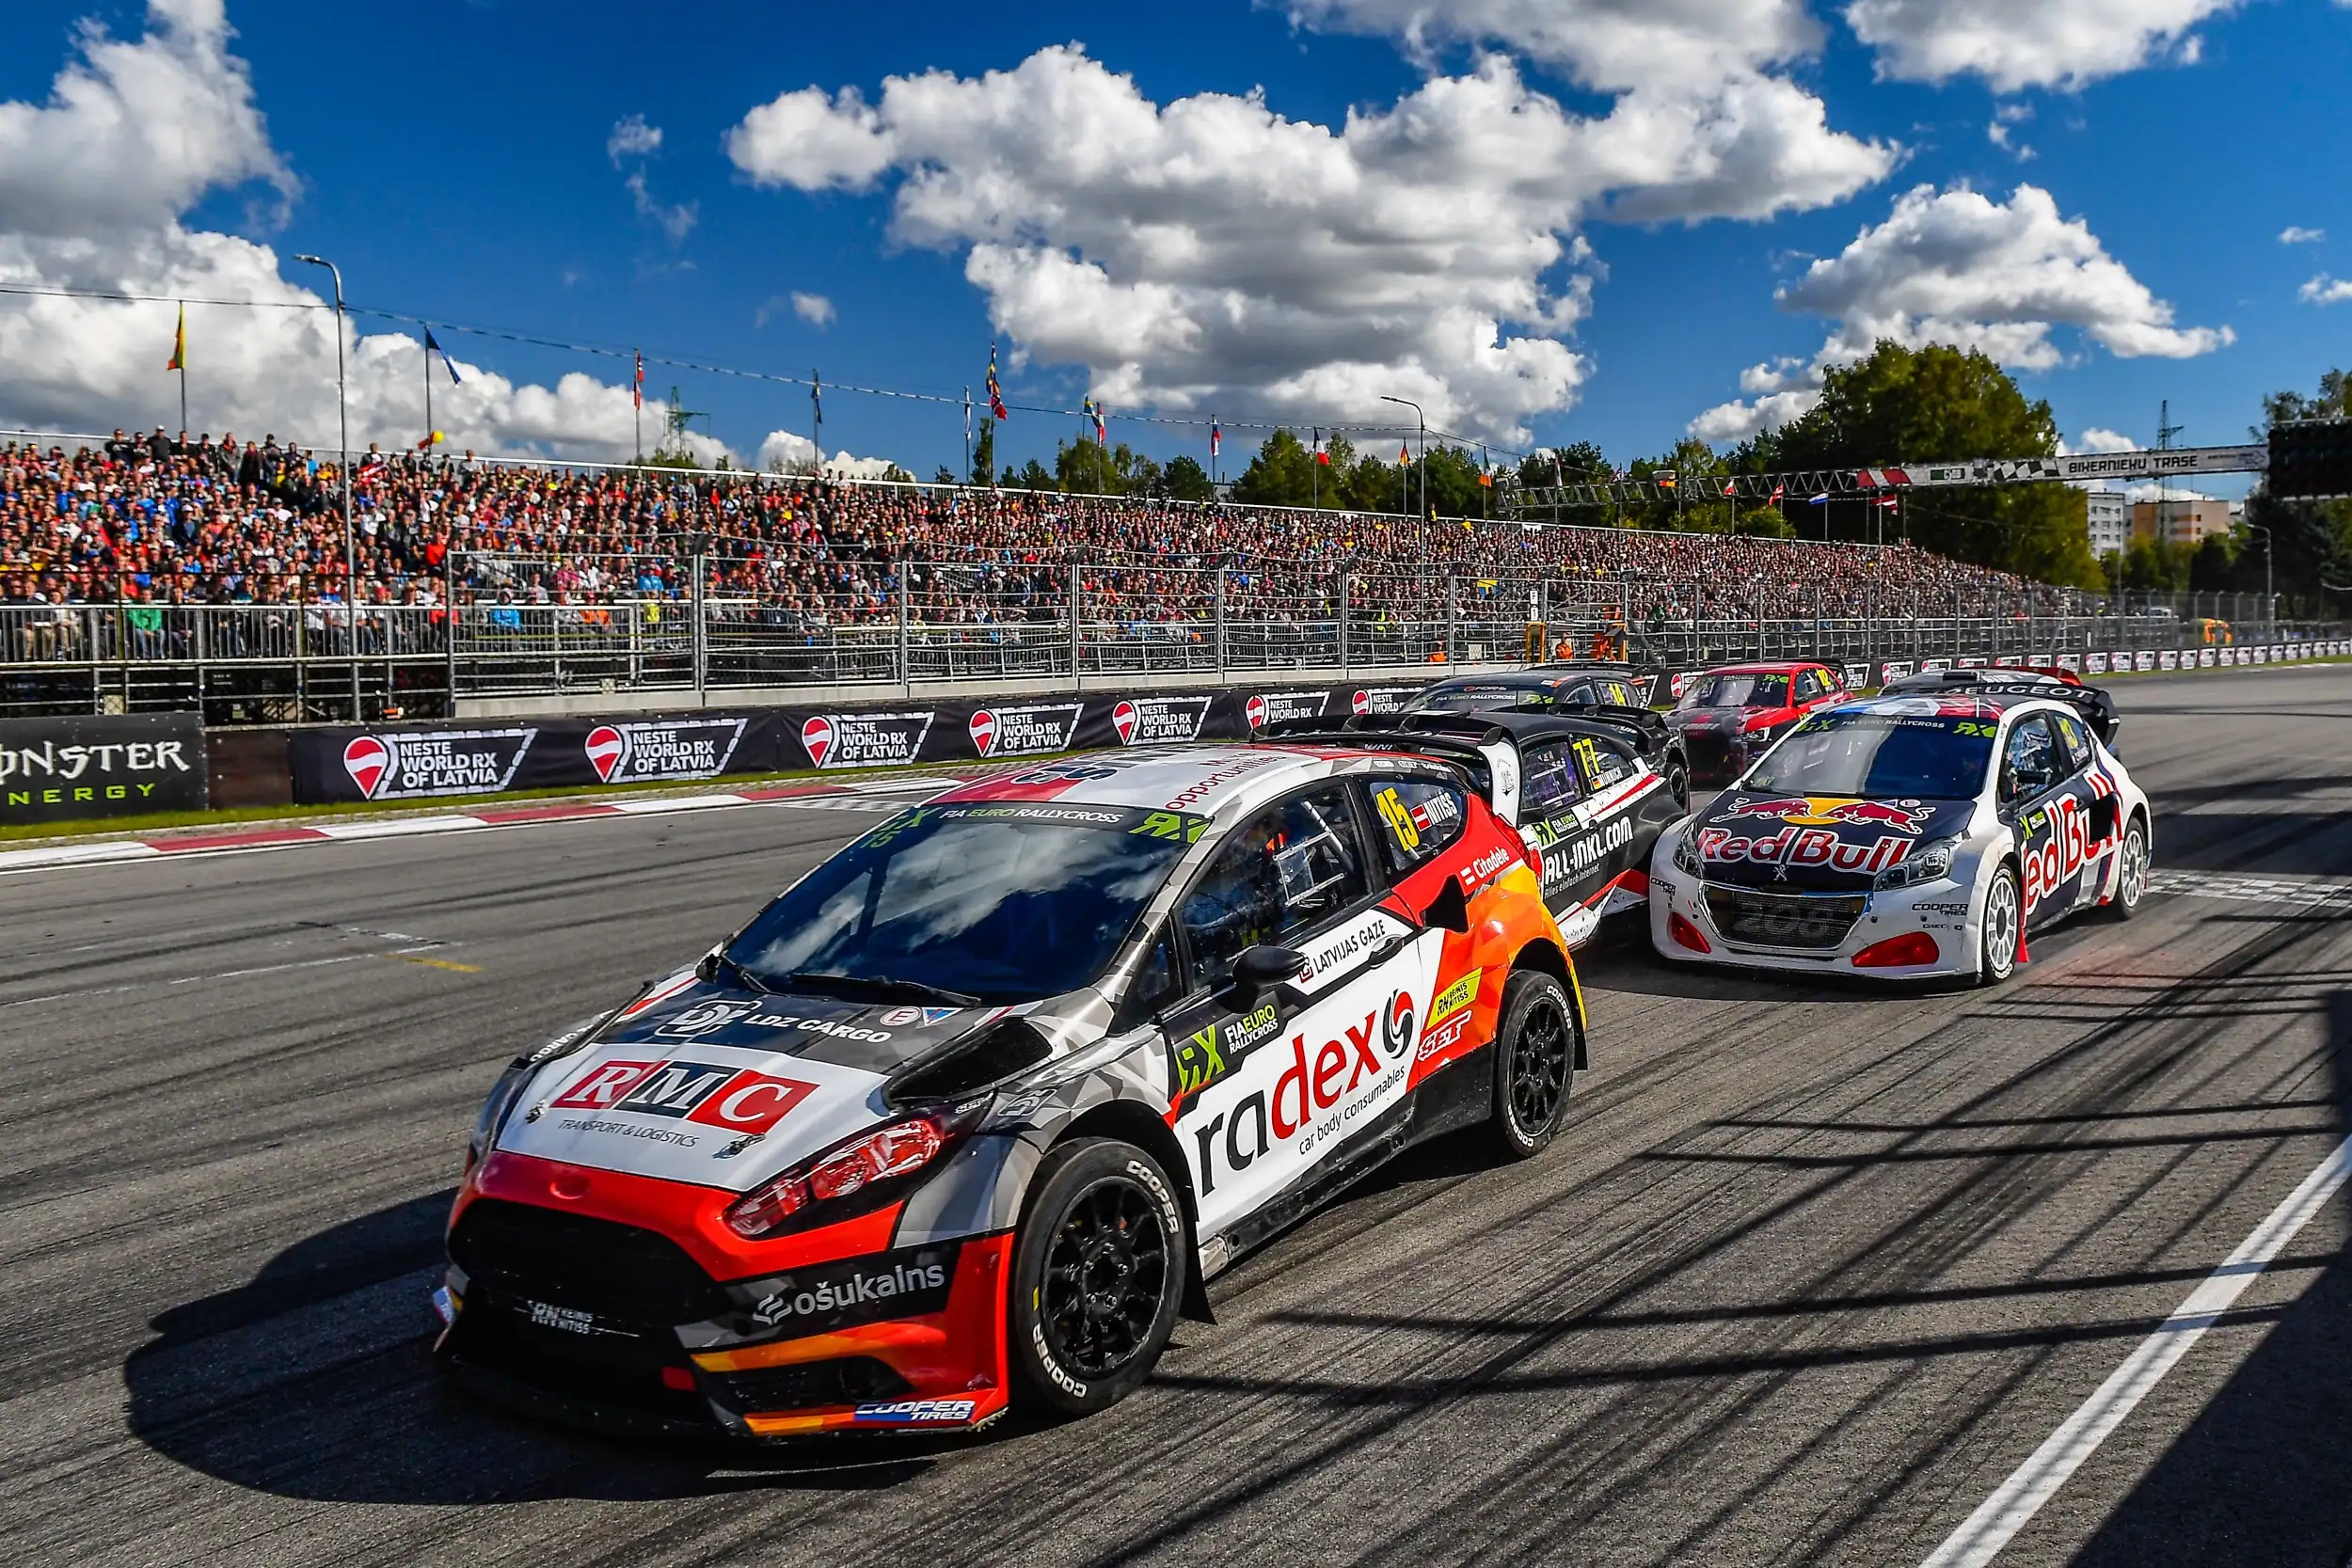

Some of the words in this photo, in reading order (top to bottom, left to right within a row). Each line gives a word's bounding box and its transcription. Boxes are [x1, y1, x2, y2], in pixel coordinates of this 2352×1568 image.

[2153, 455, 2198, 468] TRASE
[1141, 705, 1168, 715] NESTE
[1270, 699, 1293, 709] NESTE
[1270, 708, 1300, 720] WORLD
[1300, 707, 1312, 719] RX
[840, 722, 877, 734] NESTE
[1002, 714, 1034, 725] NESTE
[1003, 723, 1045, 737] WORLD
[1045, 721, 1062, 735] RX
[1141, 714, 1178, 726] WORLD
[1178, 713, 1192, 724] RX
[1884, 719, 1945, 729] RALLYCROSS
[633, 731, 677, 745] NESTE
[841, 732, 890, 747] WORLD
[890, 731, 908, 745] RX
[1143, 726, 1158, 737] OF
[1158, 724, 1193, 736] LATVIA
[400, 741, 452, 757] NESTE
[634, 742, 692, 759] WORLD
[693, 739, 716, 755] RX
[842, 747, 863, 759] OF
[863, 744, 908, 759] LATVIA
[1004, 737, 1022, 750] OF
[1022, 734, 1062, 748] LATVIA
[401, 754, 470, 773] WORLD
[471, 752, 499, 769] RX
[634, 758, 659, 773] OF
[660, 754, 716, 771] LATVIA
[1572, 737, 1600, 778] 77
[402, 771, 430, 789] OF
[433, 768, 499, 787] LATVIA
[939, 809, 966, 819] FIA
[966, 808, 1016, 818] EURO
[1014, 808, 1125, 824] RALLYCROSS
[1375, 786, 1420, 852] 15
[1696, 827, 1793, 863] Red
[1786, 831, 1915, 877] Bull
[1472, 846, 1510, 879] Citadele
[1559, 875, 1580, 893] einfach
[1733, 901, 1834, 938] 208
[1313, 935, 1359, 974] LATVIJAS
[1546, 985, 1573, 1030] COOPER
[741, 1014, 800, 1028] LDZ
[796, 1019, 893, 1043] CARGO
[1228, 1019, 1279, 1054] RALLYCROSS
[563, 1066, 794, 1122] RMC
[1194, 1009, 1382, 1199] radex
[1299, 1132, 1315, 1156] car
[1317, 1112, 1343, 1142] body
[1343, 1065, 1406, 1121] consumables
[561, 1119, 625, 1136] TRANSPORT
[625, 1125, 636, 1136] &
[634, 1128, 702, 1148] LOGISTICS
[1125, 1159, 1181, 1234] COOPER
[1032, 1321, 1088, 1399] COOPER
[854, 1400, 977, 1415] COOPER
